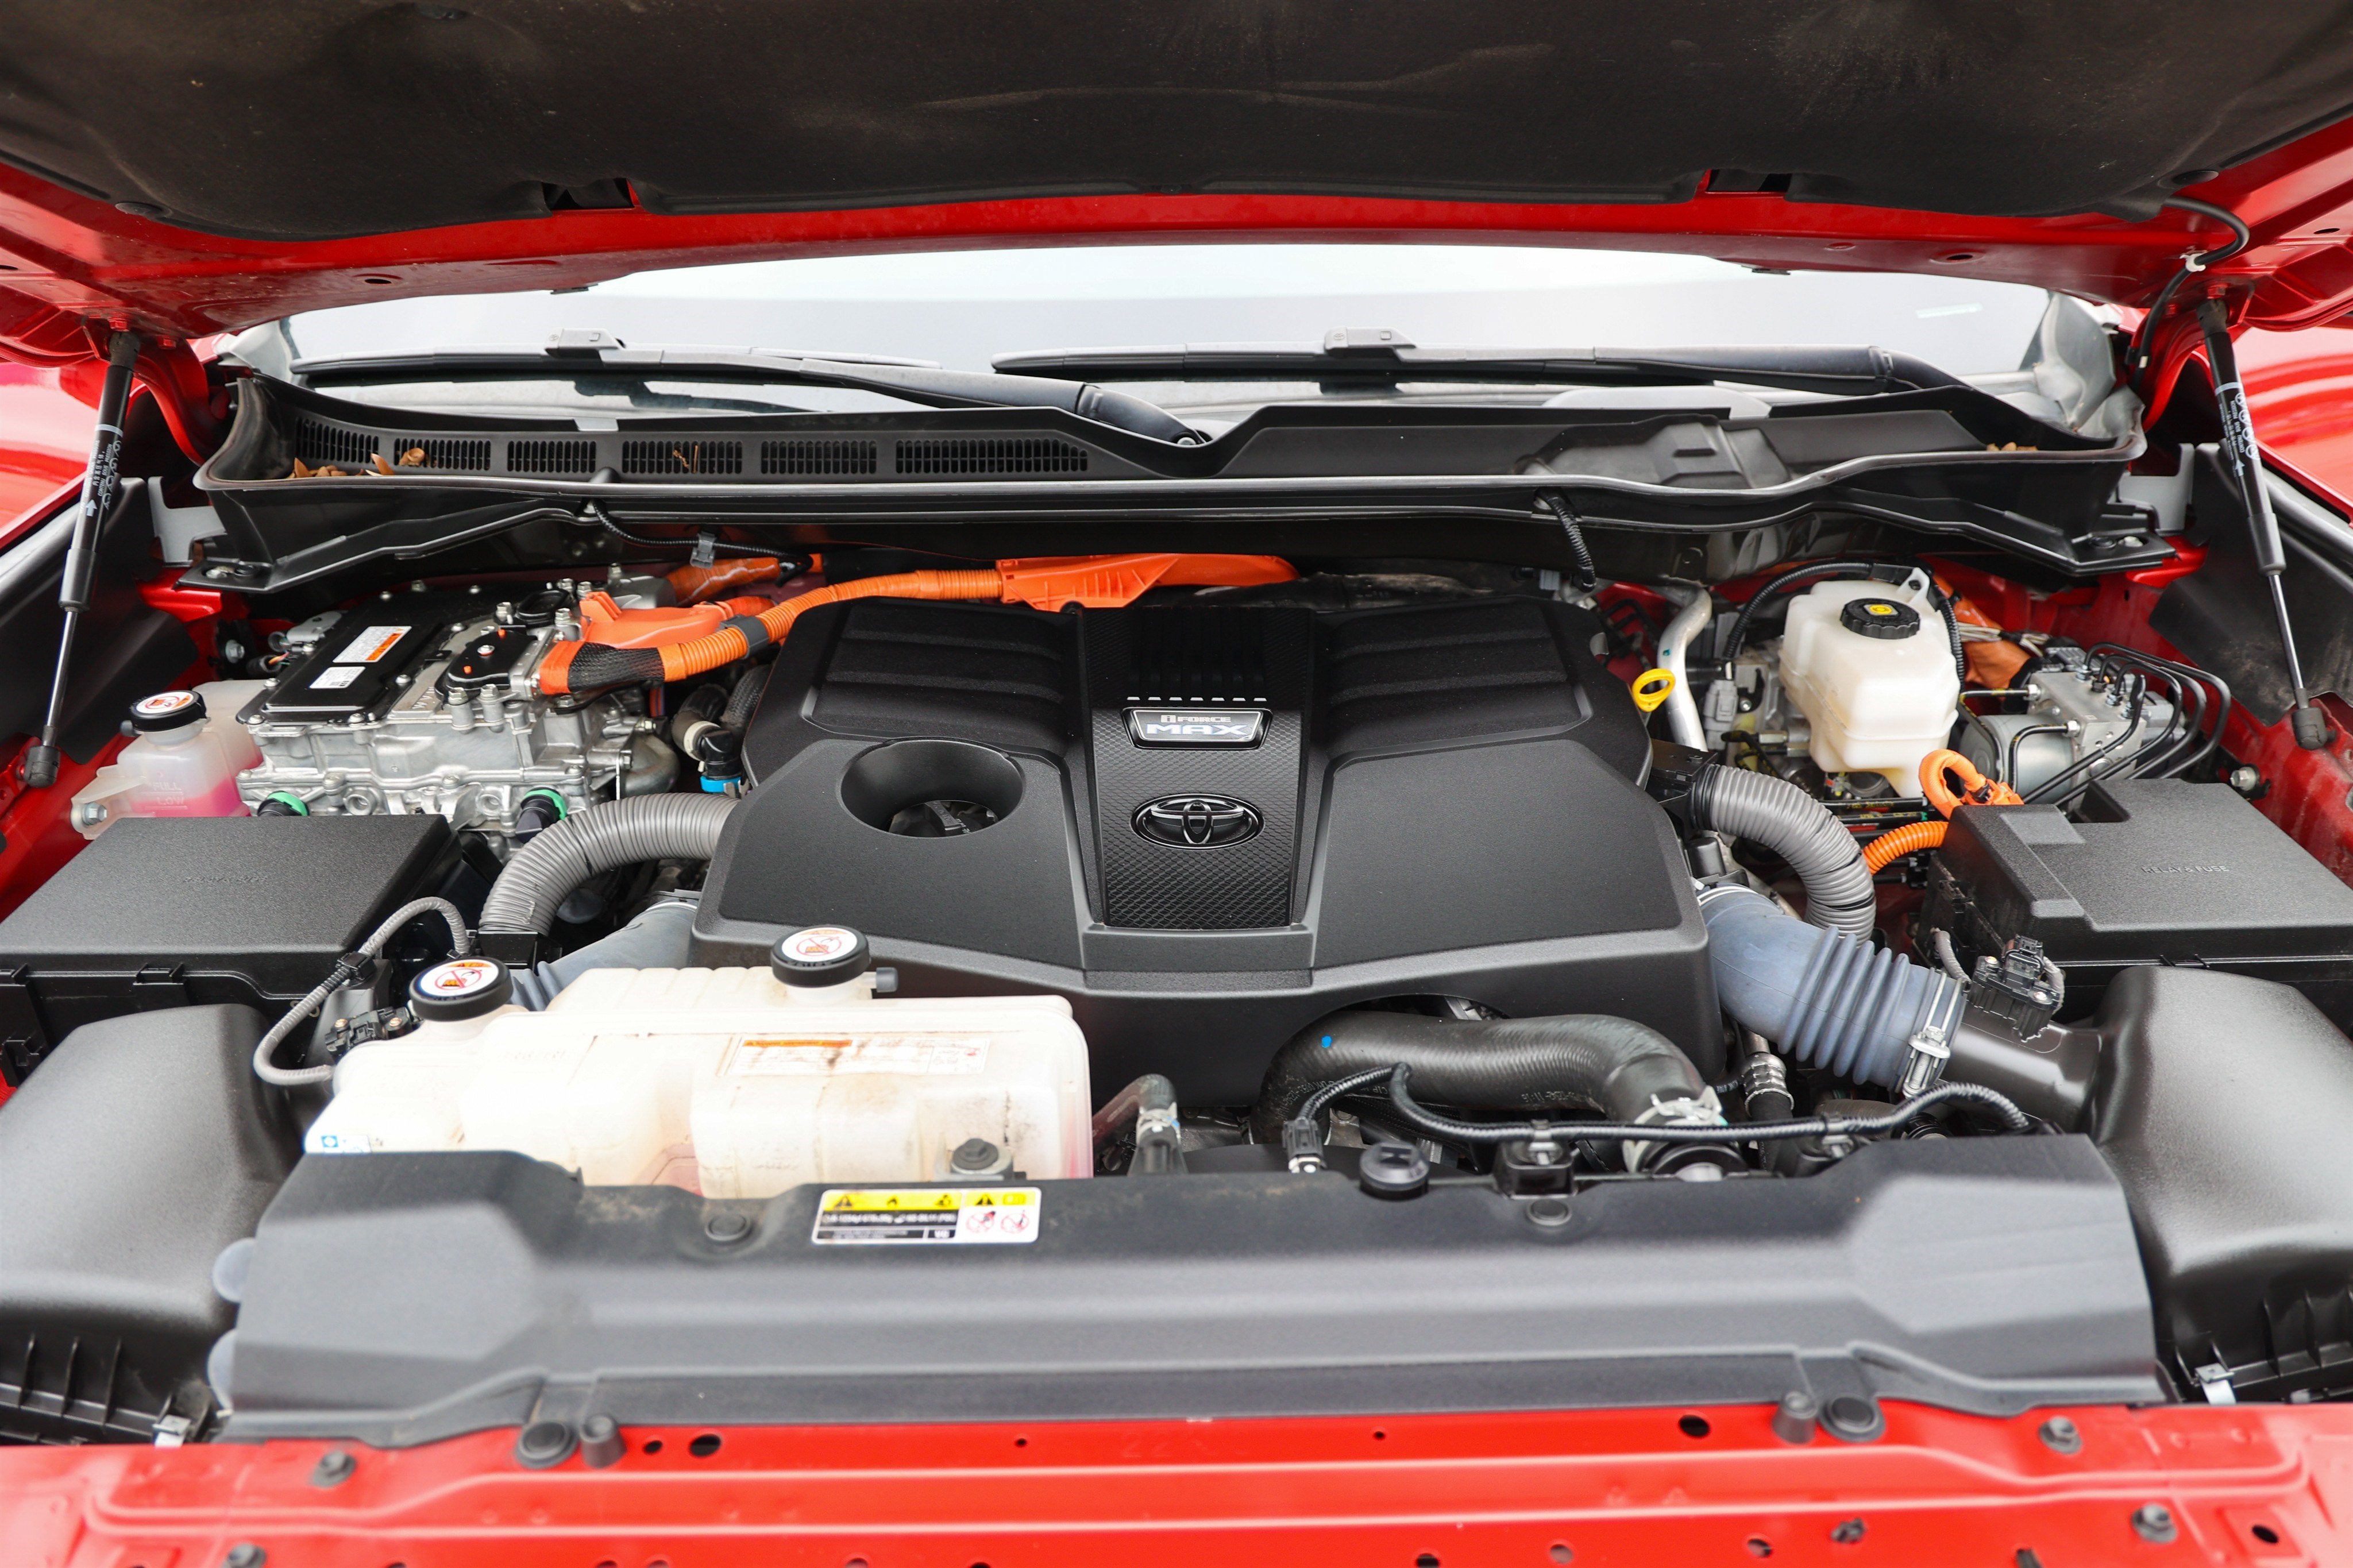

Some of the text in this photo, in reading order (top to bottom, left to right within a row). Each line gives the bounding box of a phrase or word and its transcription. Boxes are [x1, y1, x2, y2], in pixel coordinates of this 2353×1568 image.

[1146, 724, 1248, 735] MAX
[152, 782, 182, 791] FULL
[156, 796, 184, 805] LOW
